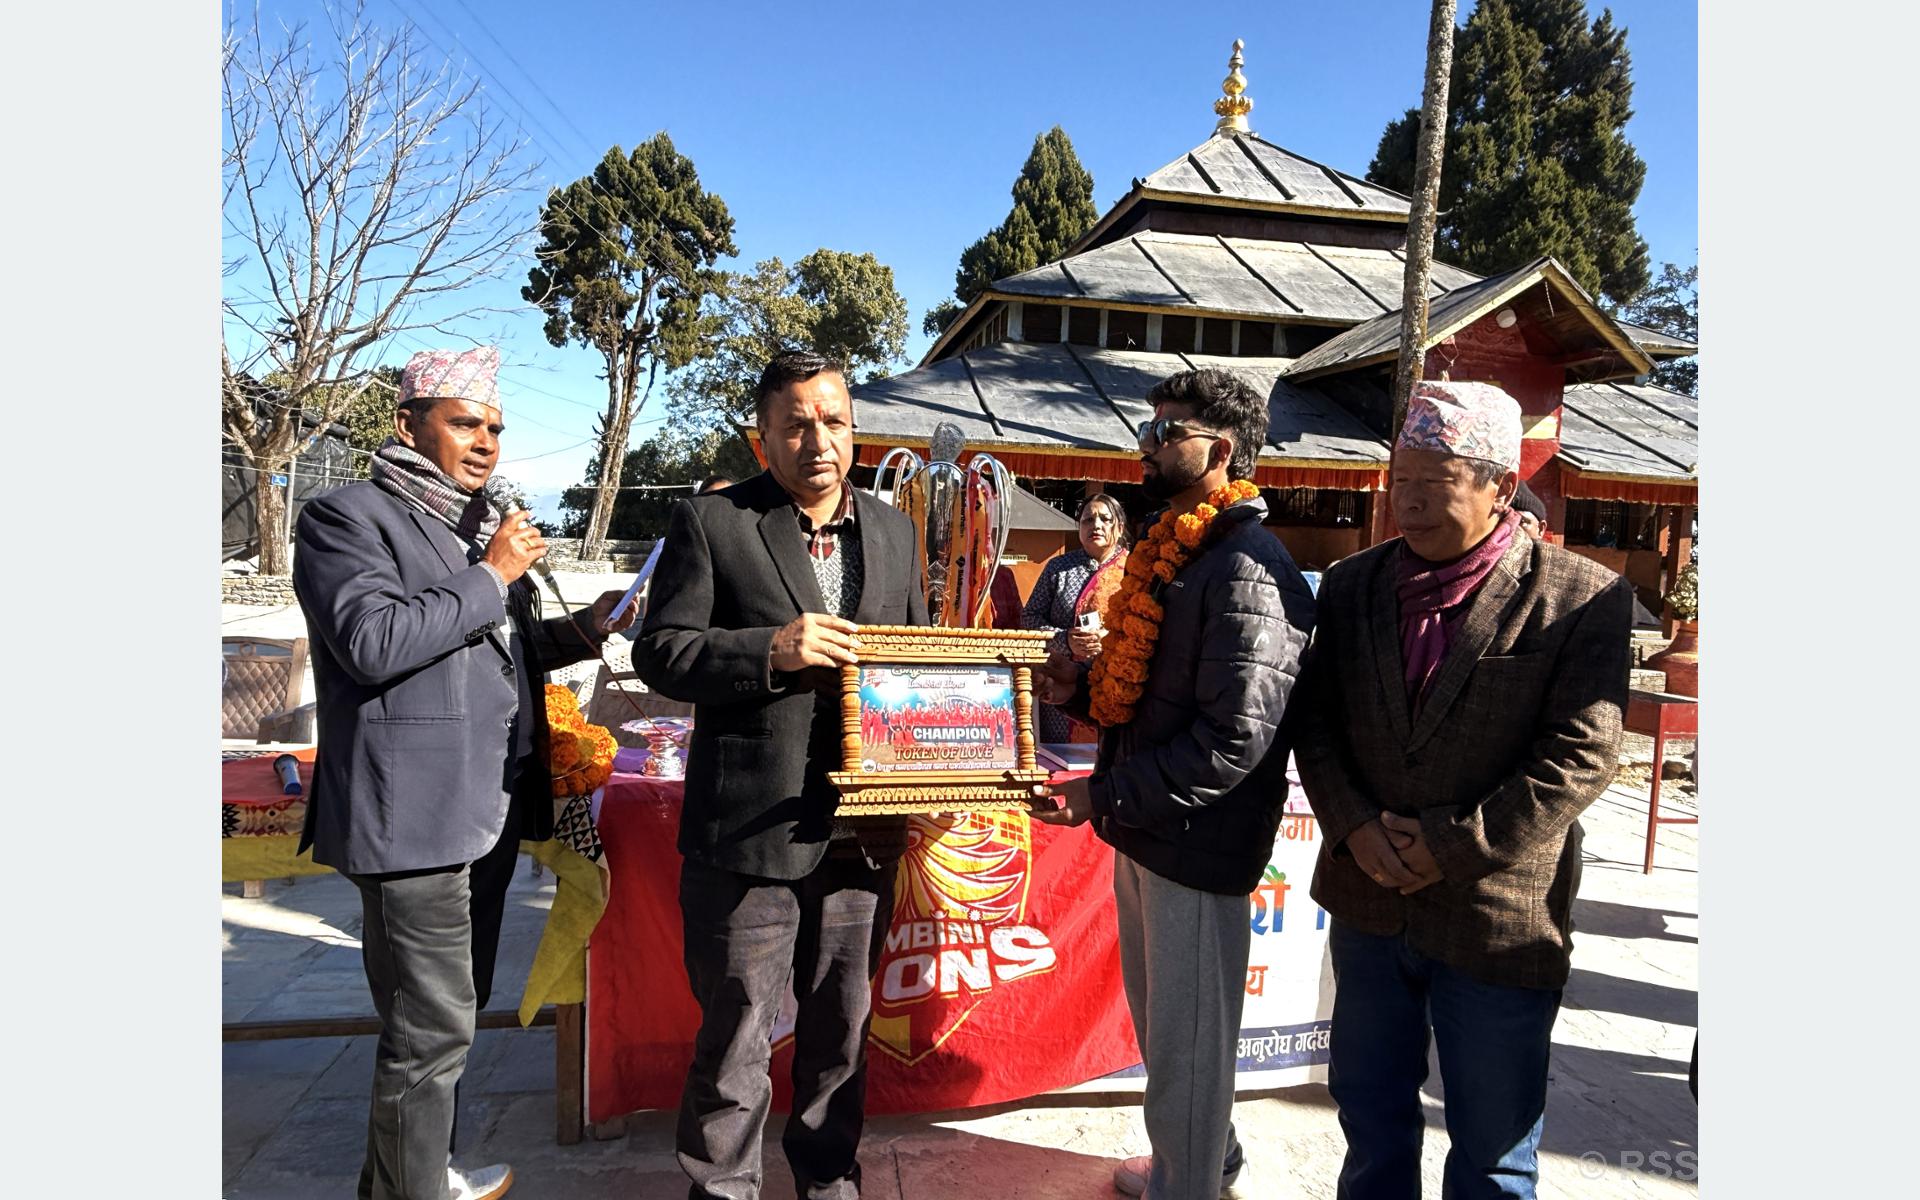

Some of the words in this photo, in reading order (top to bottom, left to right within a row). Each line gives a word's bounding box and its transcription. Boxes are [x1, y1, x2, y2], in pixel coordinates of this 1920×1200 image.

[895, 747, 939, 760] TOKEN
[939, 746, 959, 760] OF
[959, 745, 994, 759] LOVE
